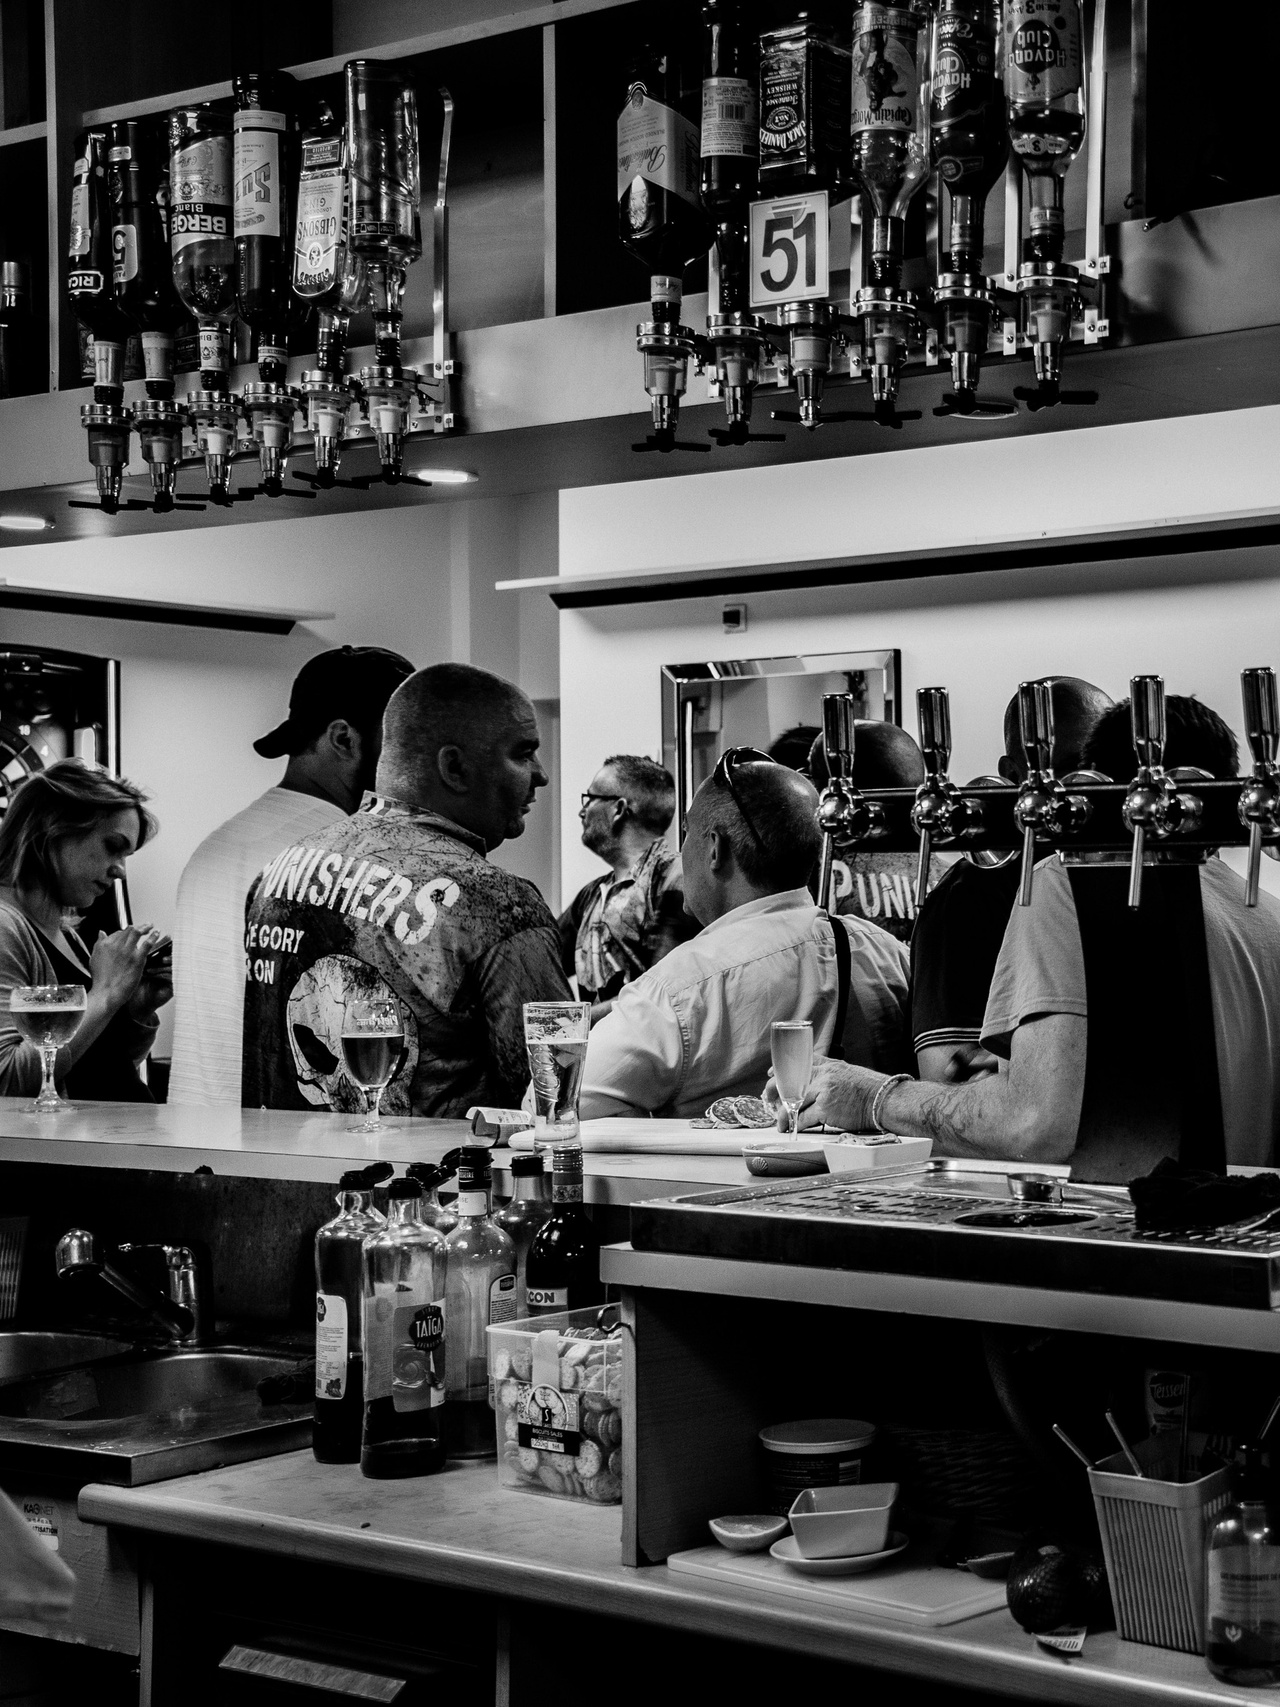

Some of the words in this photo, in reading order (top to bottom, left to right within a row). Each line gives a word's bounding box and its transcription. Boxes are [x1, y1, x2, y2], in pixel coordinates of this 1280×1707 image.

[1017, 30, 1051, 48] Club
[935, 56, 959, 73] Club
[1007, 49, 1066, 68] Havana
[766, 82, 798, 95] WHISKEY
[933, 73, 971, 90] Havan
[765, 94, 798, 107] Tennessee
[874, 106, 912, 126] Captain
[787, 120, 806, 144] JACK
[1031, 140, 1041, 152] 3
[175, 203, 204, 213] Blanc
[171, 213, 227, 234] BERGE
[113, 230, 127, 266] 5
[759, 211, 817, 293] 51
[68, 274, 95, 288] RICA
[246, 922, 305, 954] EGORY
[33, 1525, 58, 1535] TISATION
